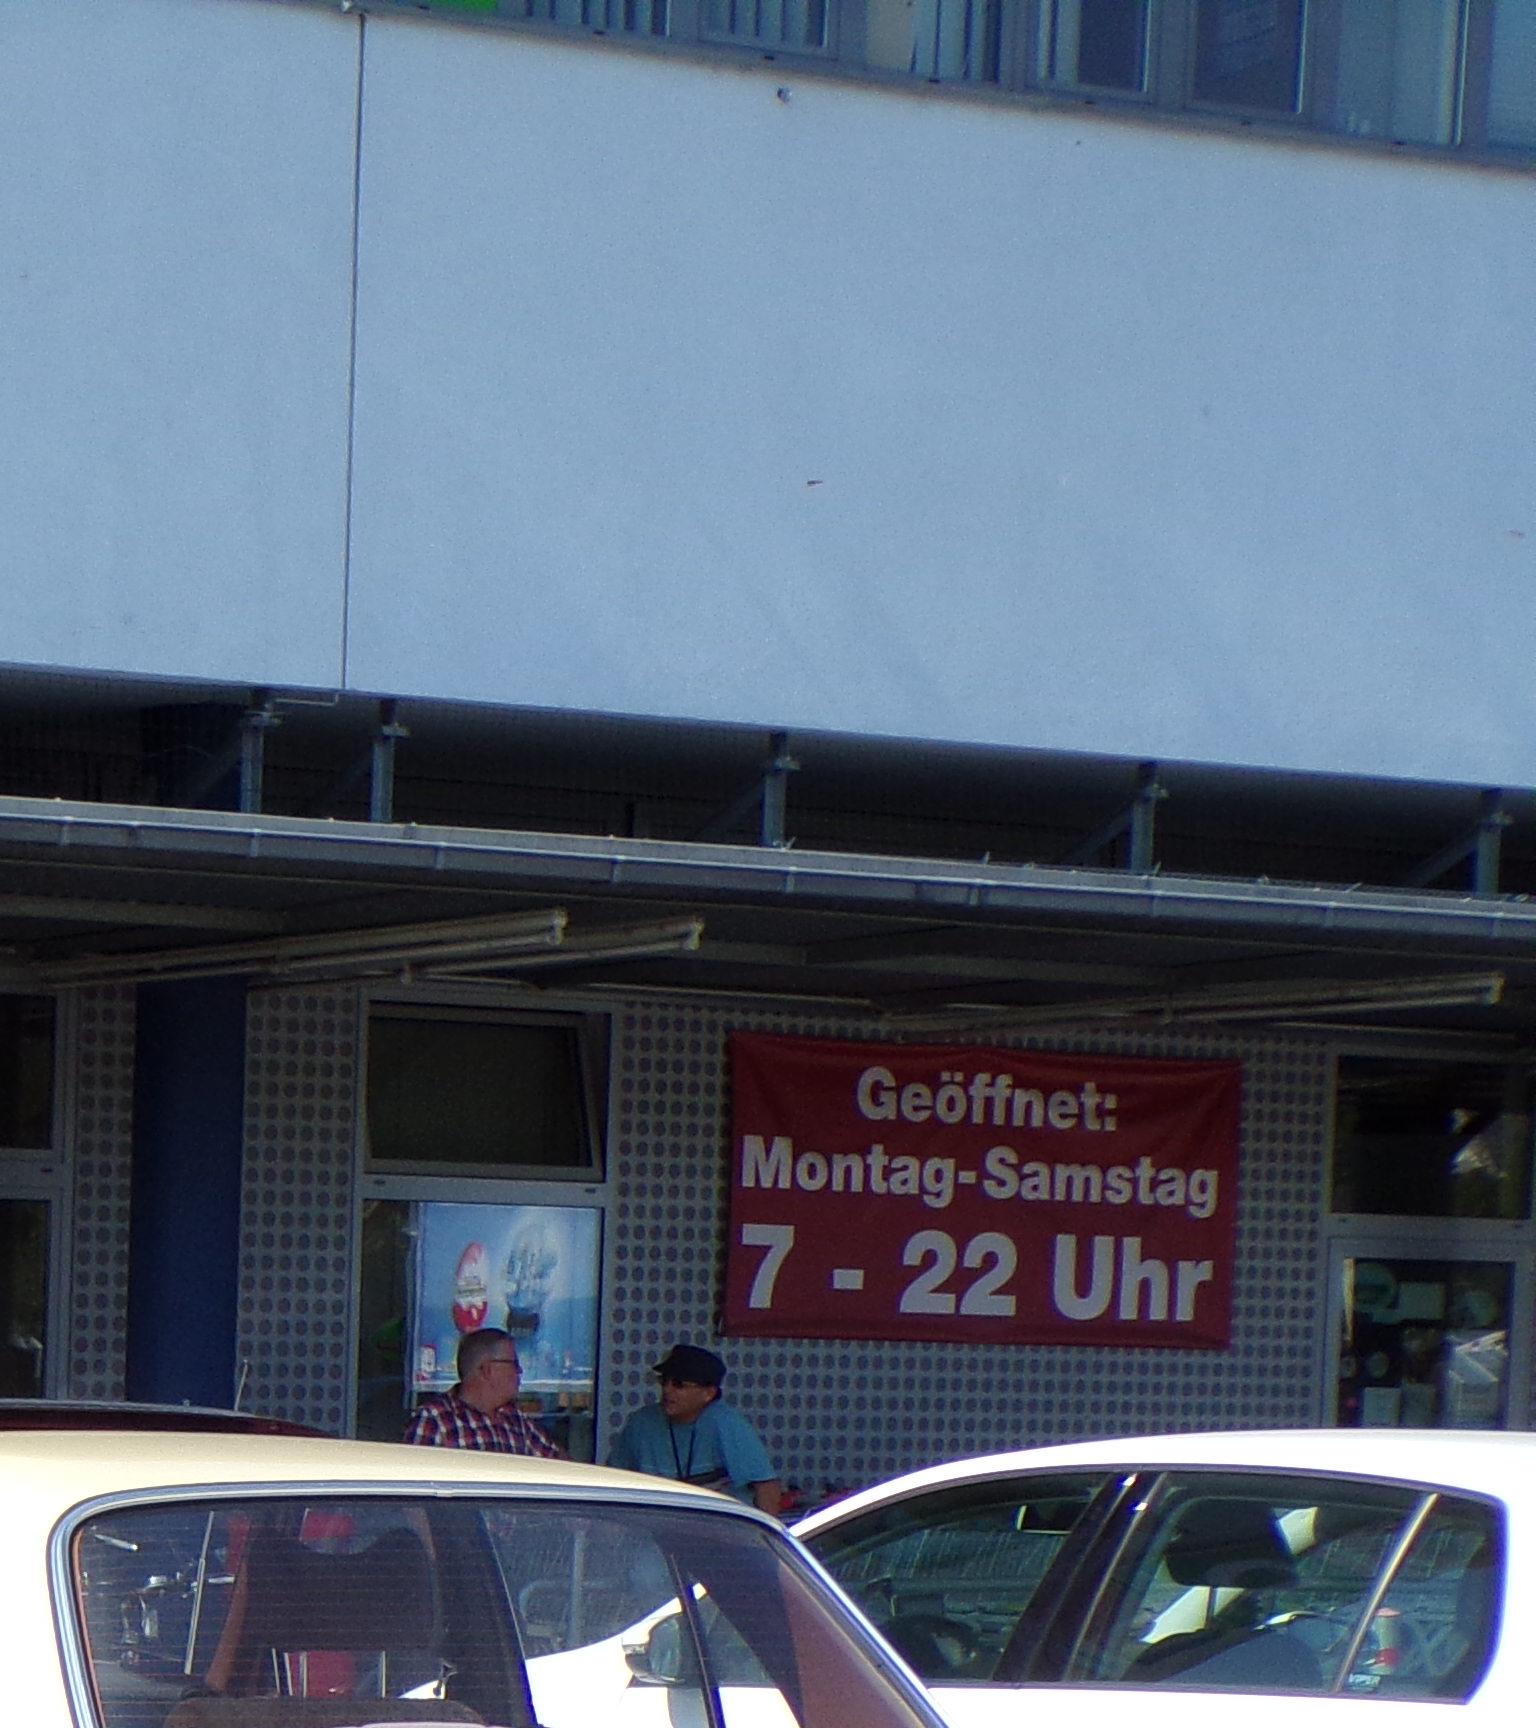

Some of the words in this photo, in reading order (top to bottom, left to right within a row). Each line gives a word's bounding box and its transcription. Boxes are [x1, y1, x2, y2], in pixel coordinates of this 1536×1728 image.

[857, 1066, 1118, 1131] Geöffnet:
[741, 1135, 1219, 1218] Montag-Samstag
[741, 1223, 795, 1309] 7
[899, 1230, 1017, 1317] 22
[1053, 1233, 1213, 1321] Uhr
